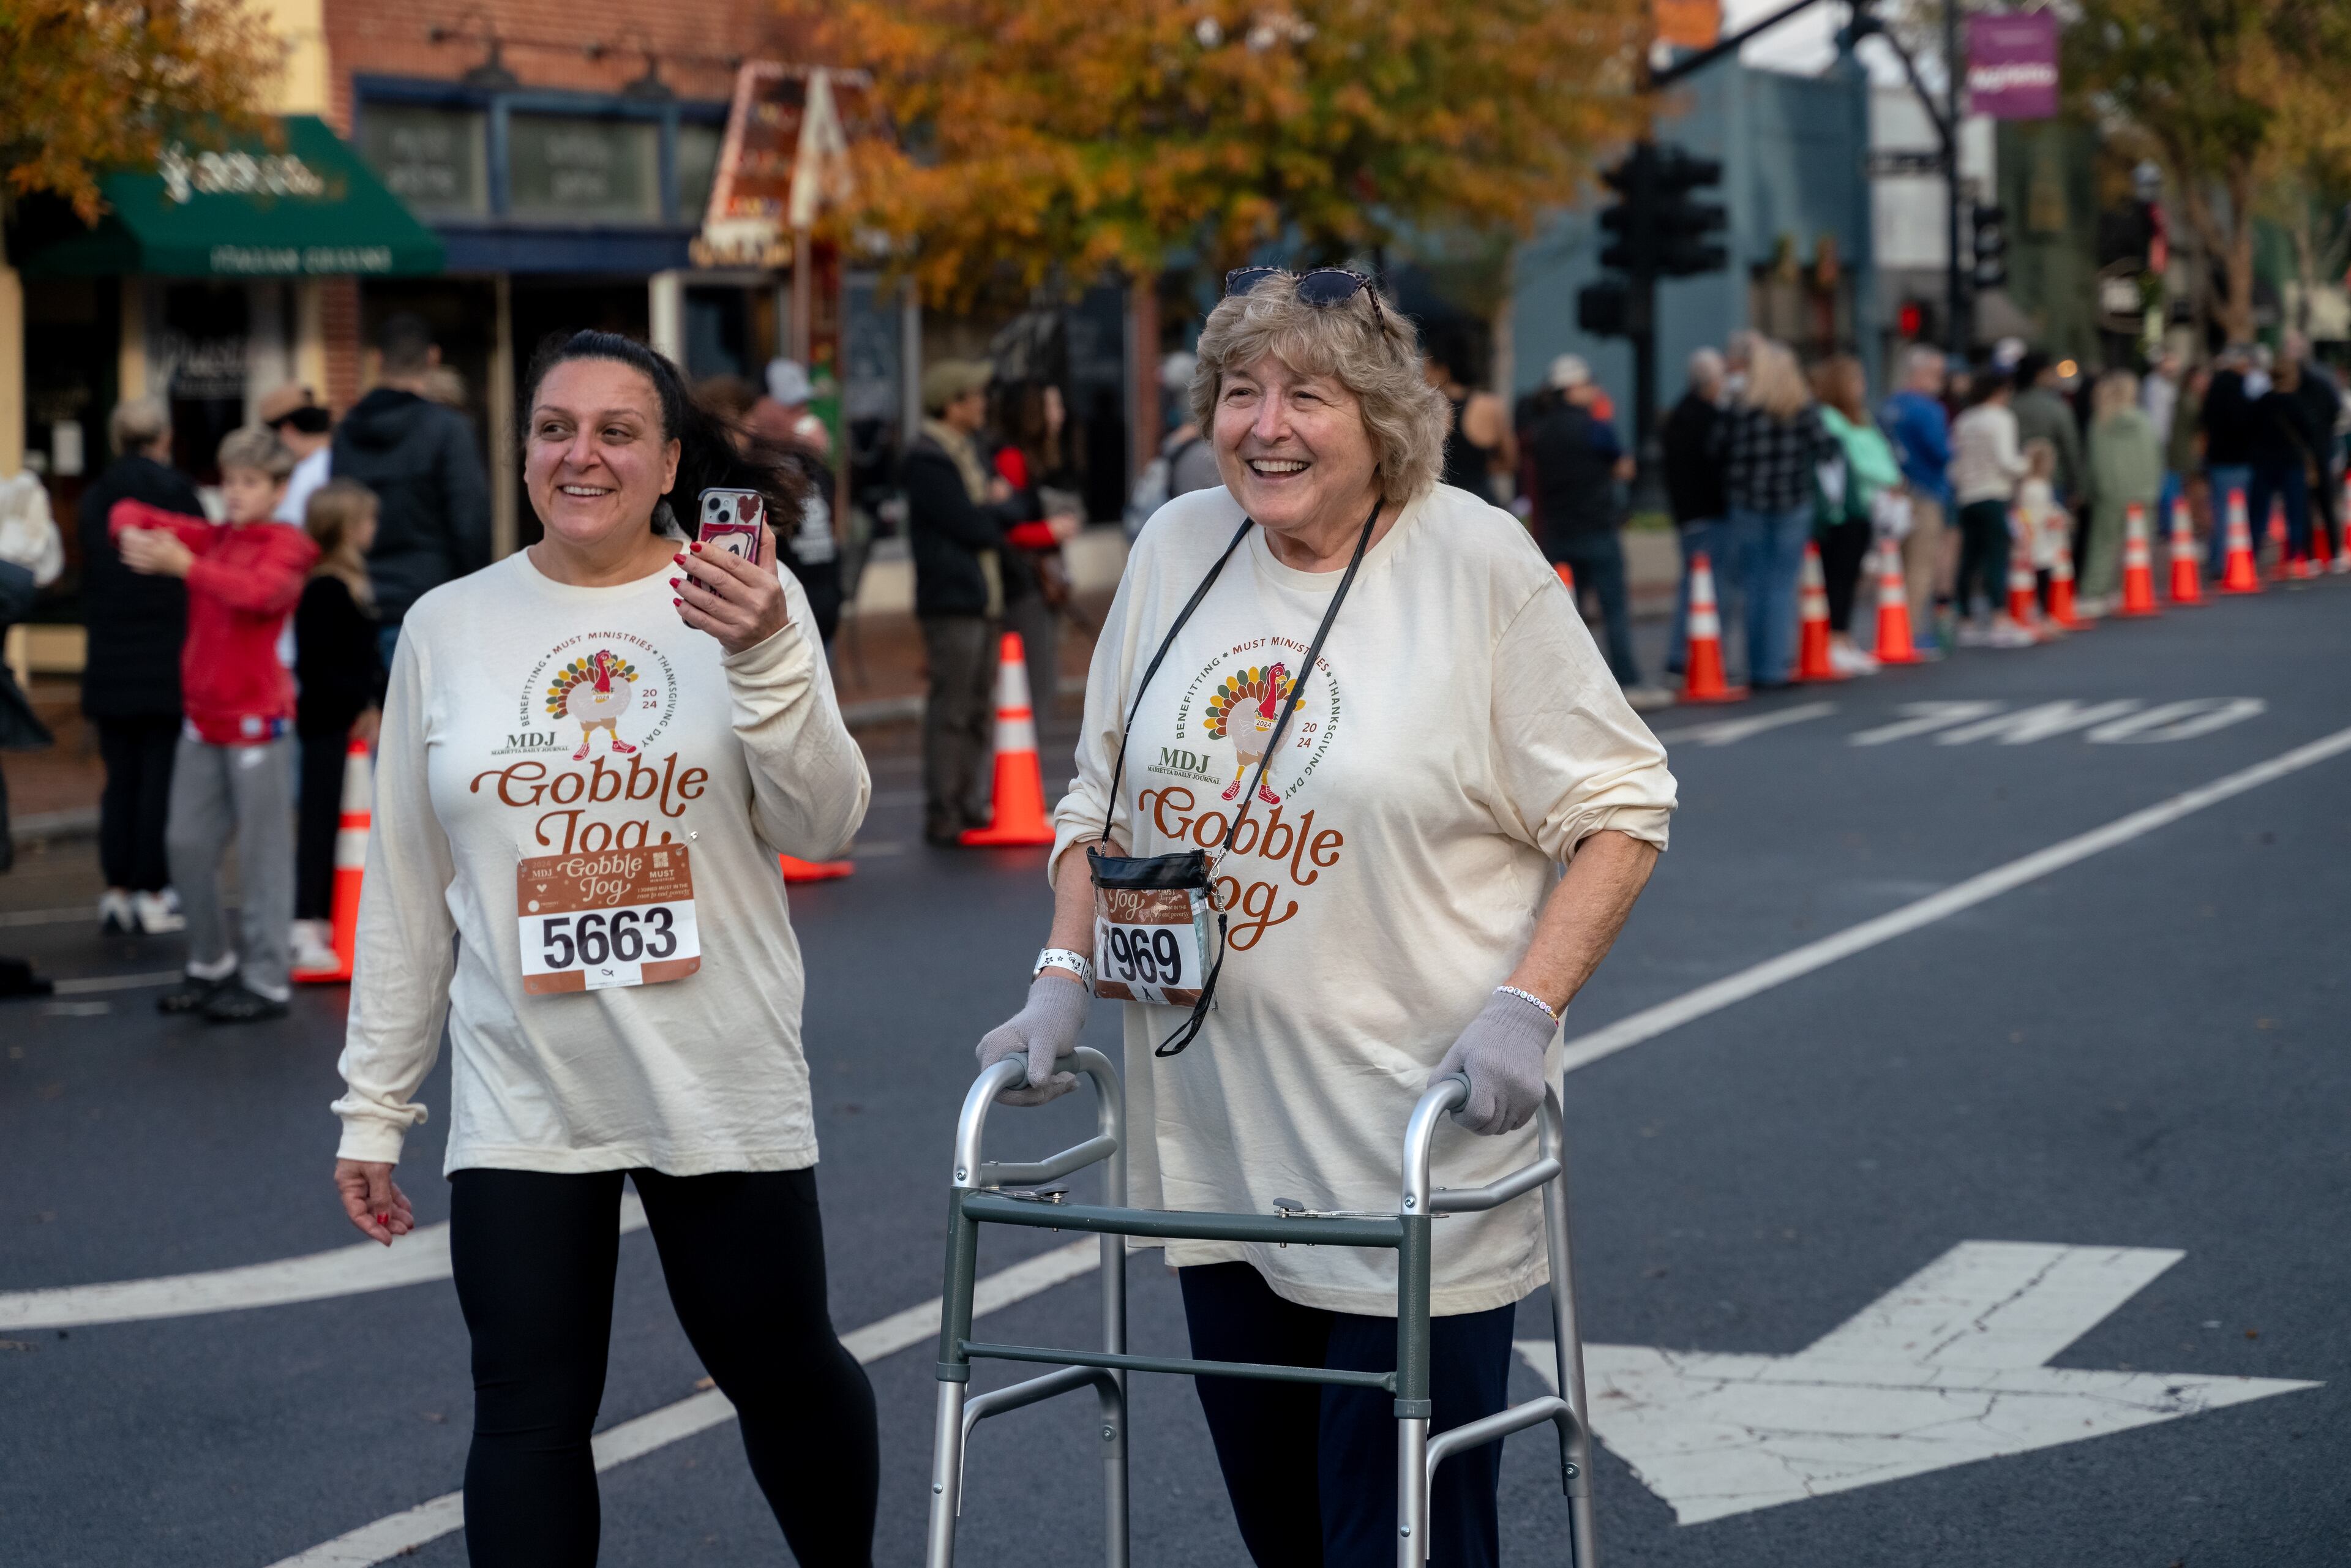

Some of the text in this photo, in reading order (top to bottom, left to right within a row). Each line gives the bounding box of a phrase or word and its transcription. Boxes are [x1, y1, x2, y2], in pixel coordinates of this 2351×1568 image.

[1232, 638, 1266, 655] MUST
[520, 631, 677, 748] BENEFITTING MUST MINISTRIES THANKSGIVING DAY
[642, 688, 658, 697] 20
[1176, 658, 1220, 740] BENEFITTING
[642, 700, 657, 709] 24
[1256, 719, 1272, 728] 2024
[1302, 722, 1318, 733] 20
[1304, 679, 1340, 776] THANKSGIVING
[505, 731, 557, 748] MDJ
[1297, 737, 1312, 748] 24
[1158, 746, 1212, 774] MDJ
[470, 752, 708, 818] Gobble
[1147, 766, 1221, 785] MARIETTA DAILY JOURNAL
[1284, 777, 1305, 800] DAY
[1138, 786, 1344, 886] Gobble
[532, 868, 552, 877] MDJ
[557, 853, 642, 879] Gobble
[649, 869, 675, 879] MUST
[579, 876, 631, 906] Jog
[1205, 855, 1299, 951] og
[1109, 889, 1146, 921] Jog
[542, 907, 677, 969] 5663
